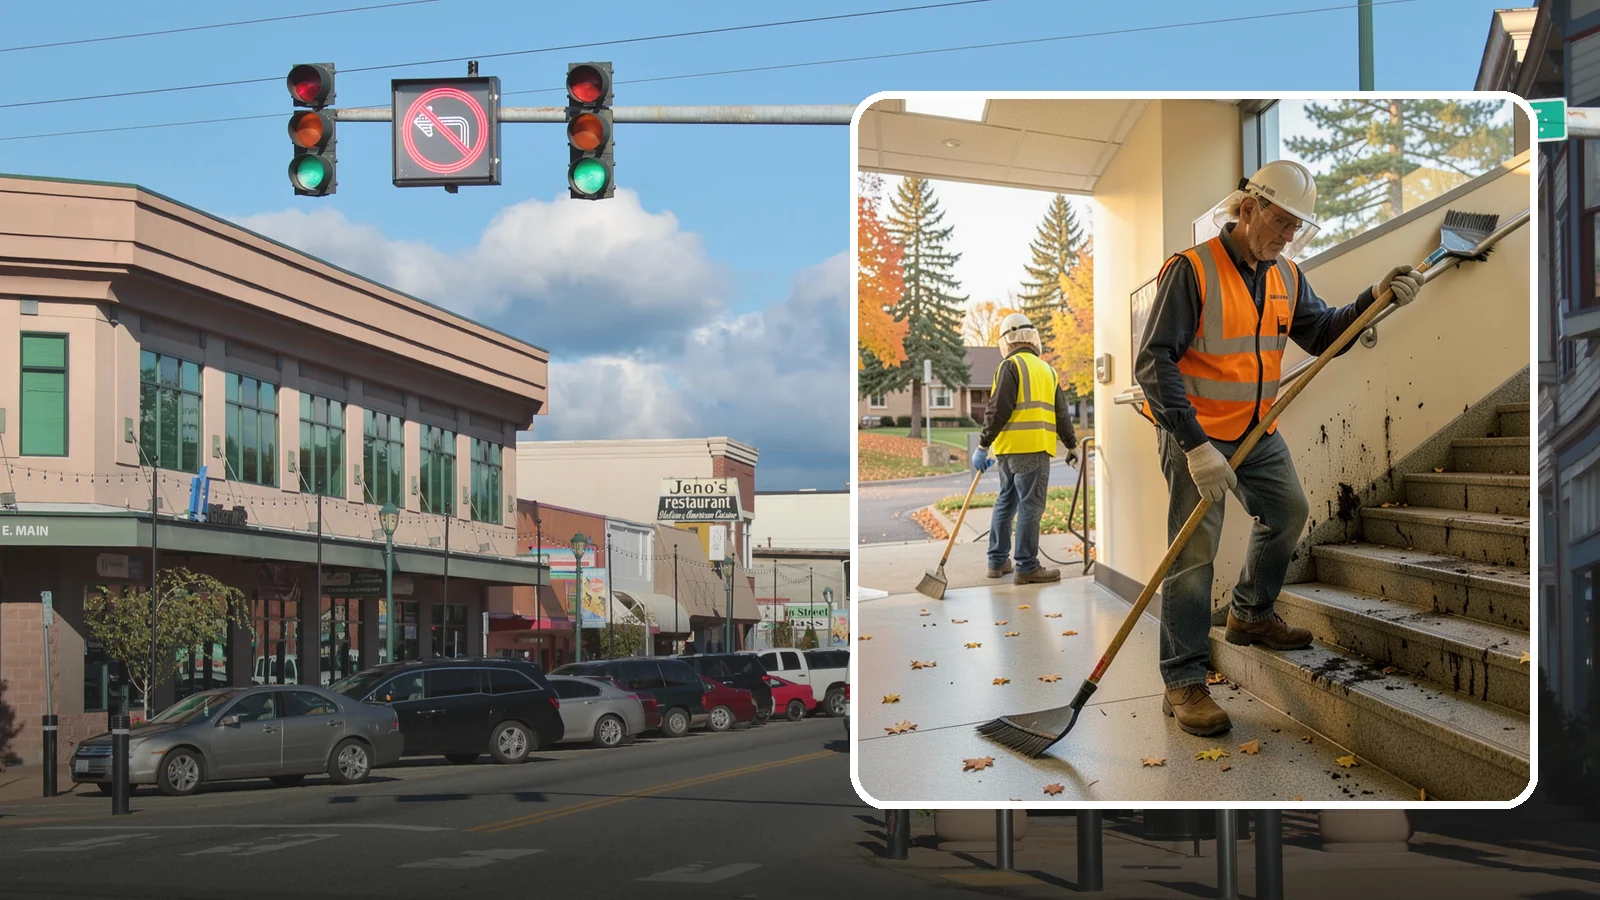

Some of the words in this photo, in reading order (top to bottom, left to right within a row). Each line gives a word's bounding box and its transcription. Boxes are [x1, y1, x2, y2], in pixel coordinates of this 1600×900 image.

[669, 480, 728, 494] Jeno's
[665, 496, 731, 509] restaurant
[2, 525, 13, 536] E.
[15, 525, 49, 536] MAIN
[797, 607, 828, 617] Street
